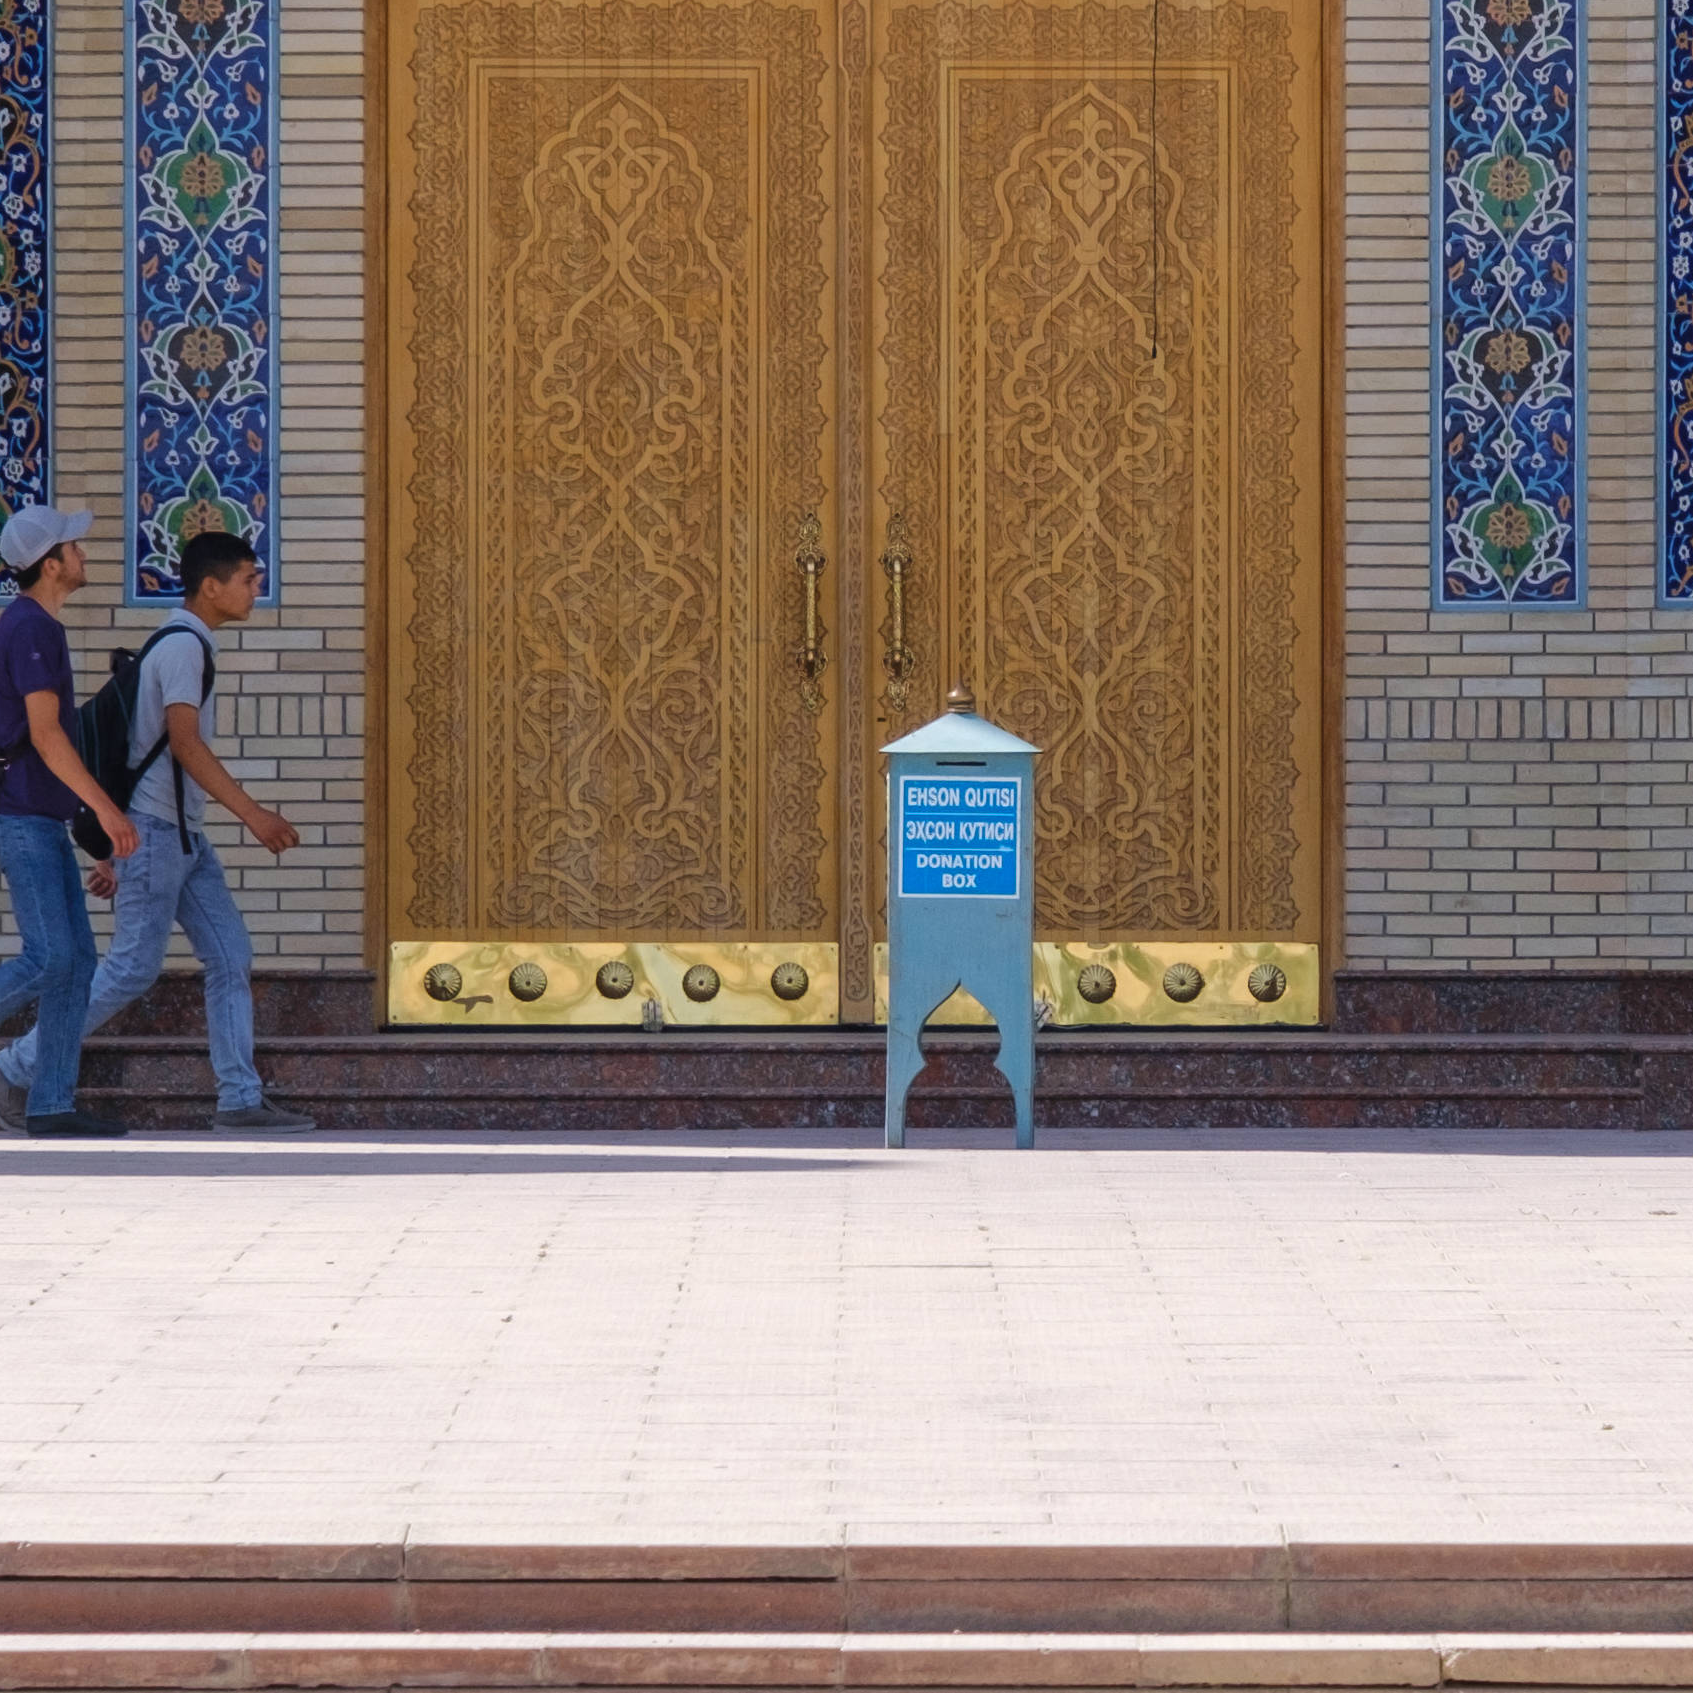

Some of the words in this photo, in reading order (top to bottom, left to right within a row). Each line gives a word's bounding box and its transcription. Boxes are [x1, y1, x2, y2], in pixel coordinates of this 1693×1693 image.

[908, 787, 959, 806] EHSON
[965, 788, 1014, 807] QUTISI
[906, 821, 955, 844] ЭҲСОН
[916, 854, 1002, 868] DONATION
[942, 873, 977, 887] BOX
